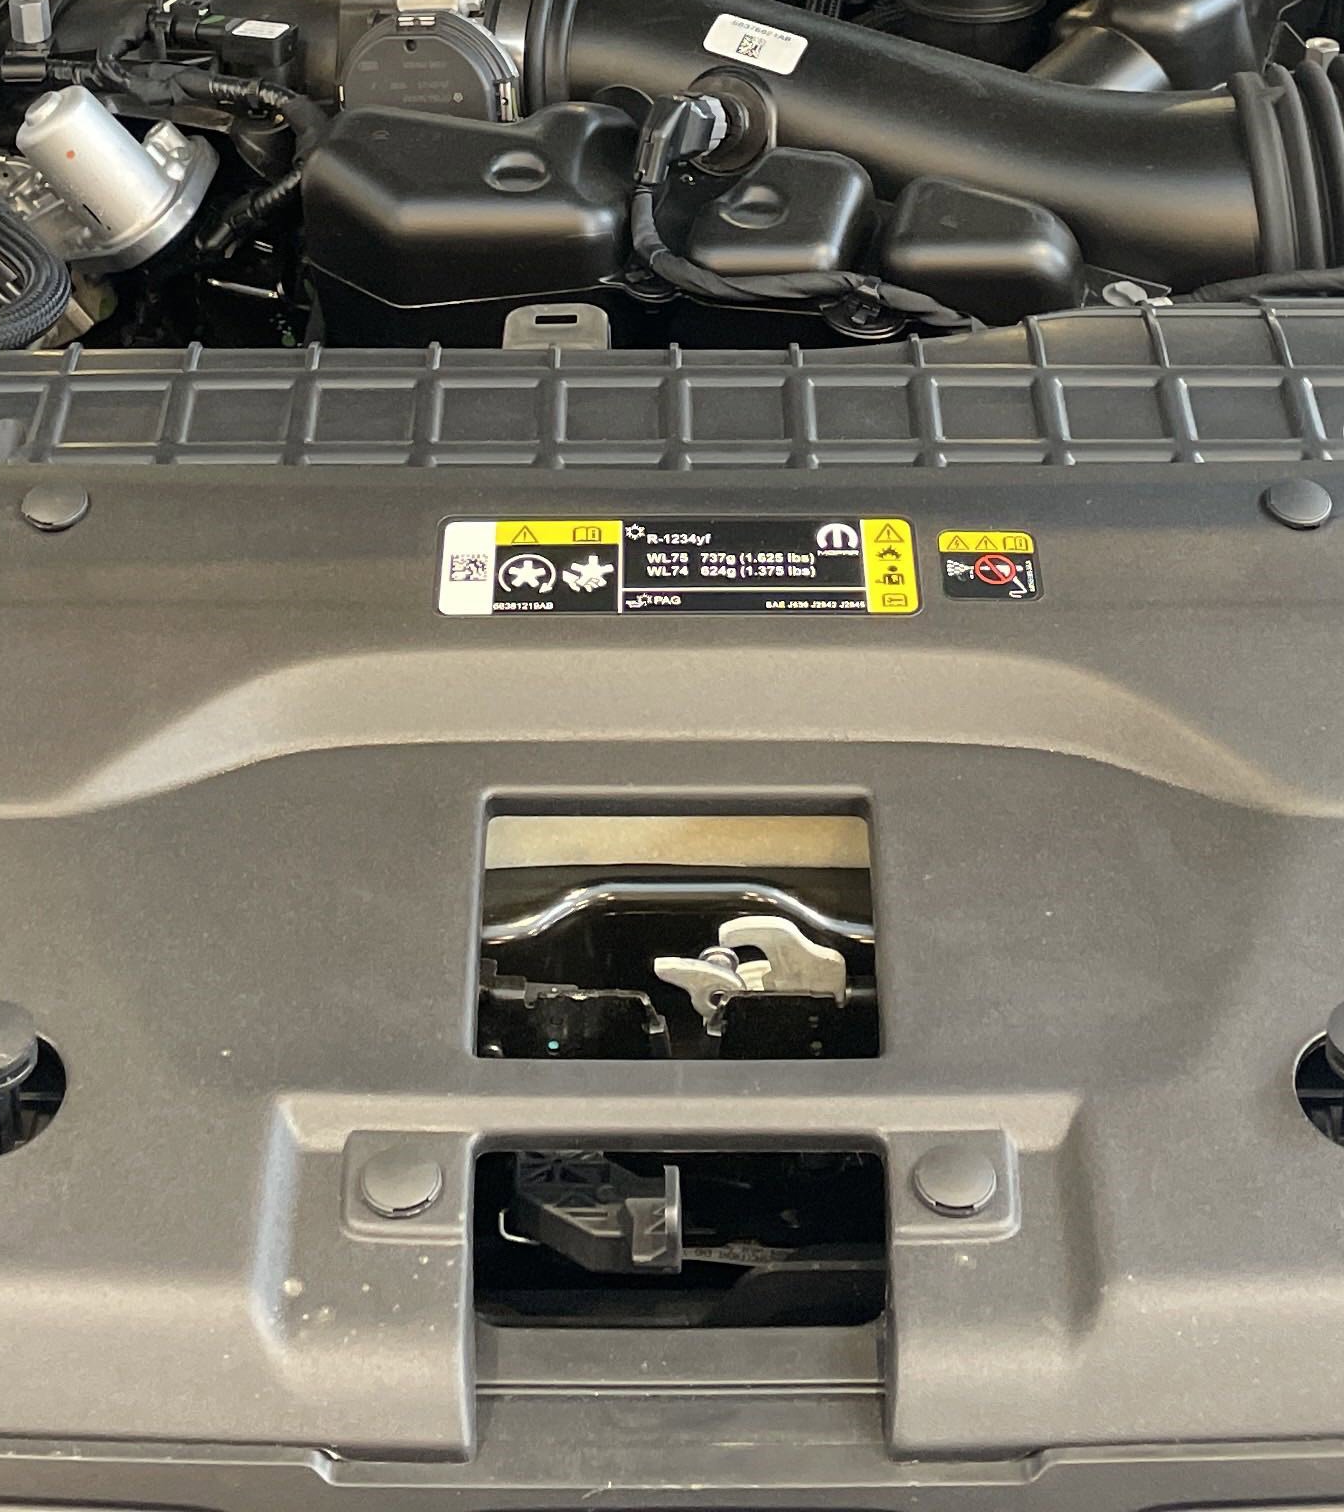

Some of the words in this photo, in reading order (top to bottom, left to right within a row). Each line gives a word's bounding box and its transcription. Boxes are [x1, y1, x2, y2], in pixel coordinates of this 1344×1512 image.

[646, 532, 712, 546] R-1234yf
[646, 552, 689, 564] WL75
[700, 552, 736, 566] 737g
[787, 552, 815, 565] lbs)
[646, 565, 689, 577] WL74
[788, 565, 817, 578] lbs)
[653, 595, 682, 606] PAG
